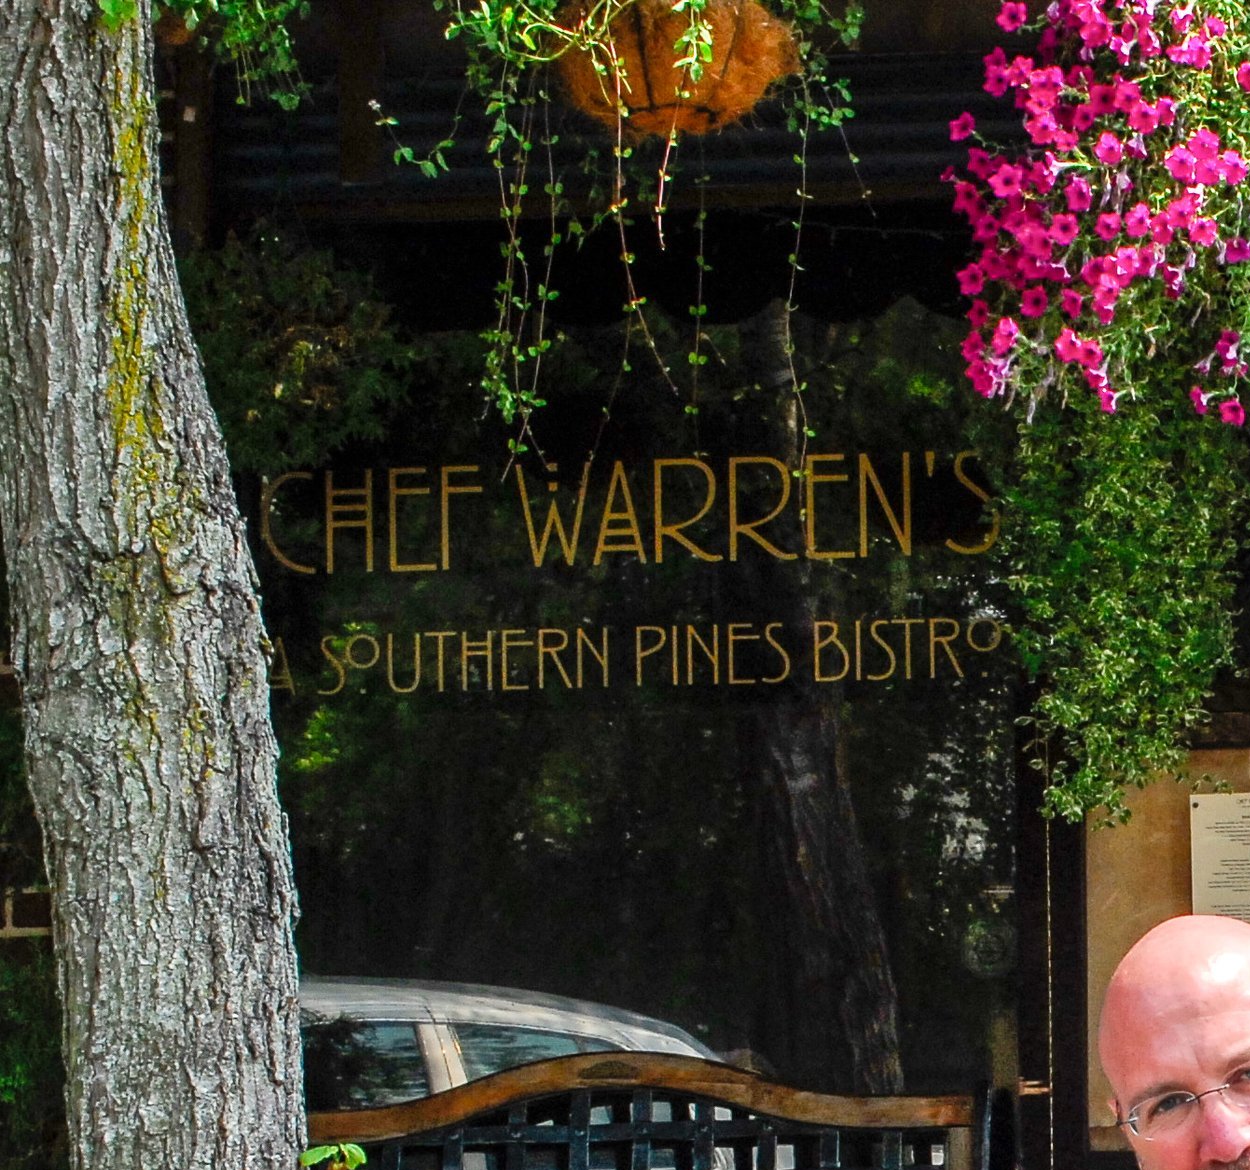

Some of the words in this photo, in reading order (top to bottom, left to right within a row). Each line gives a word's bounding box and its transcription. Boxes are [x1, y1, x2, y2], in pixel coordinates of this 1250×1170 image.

[260, 465, 483, 574] CHEF
[515, 450, 1001, 566] WARREN'S
[269, 636, 296, 696] A
[317, 627, 608, 695] SOUTHERN
[635, 622, 791, 686] PINES
[814, 617, 1001, 682] BISTRO
